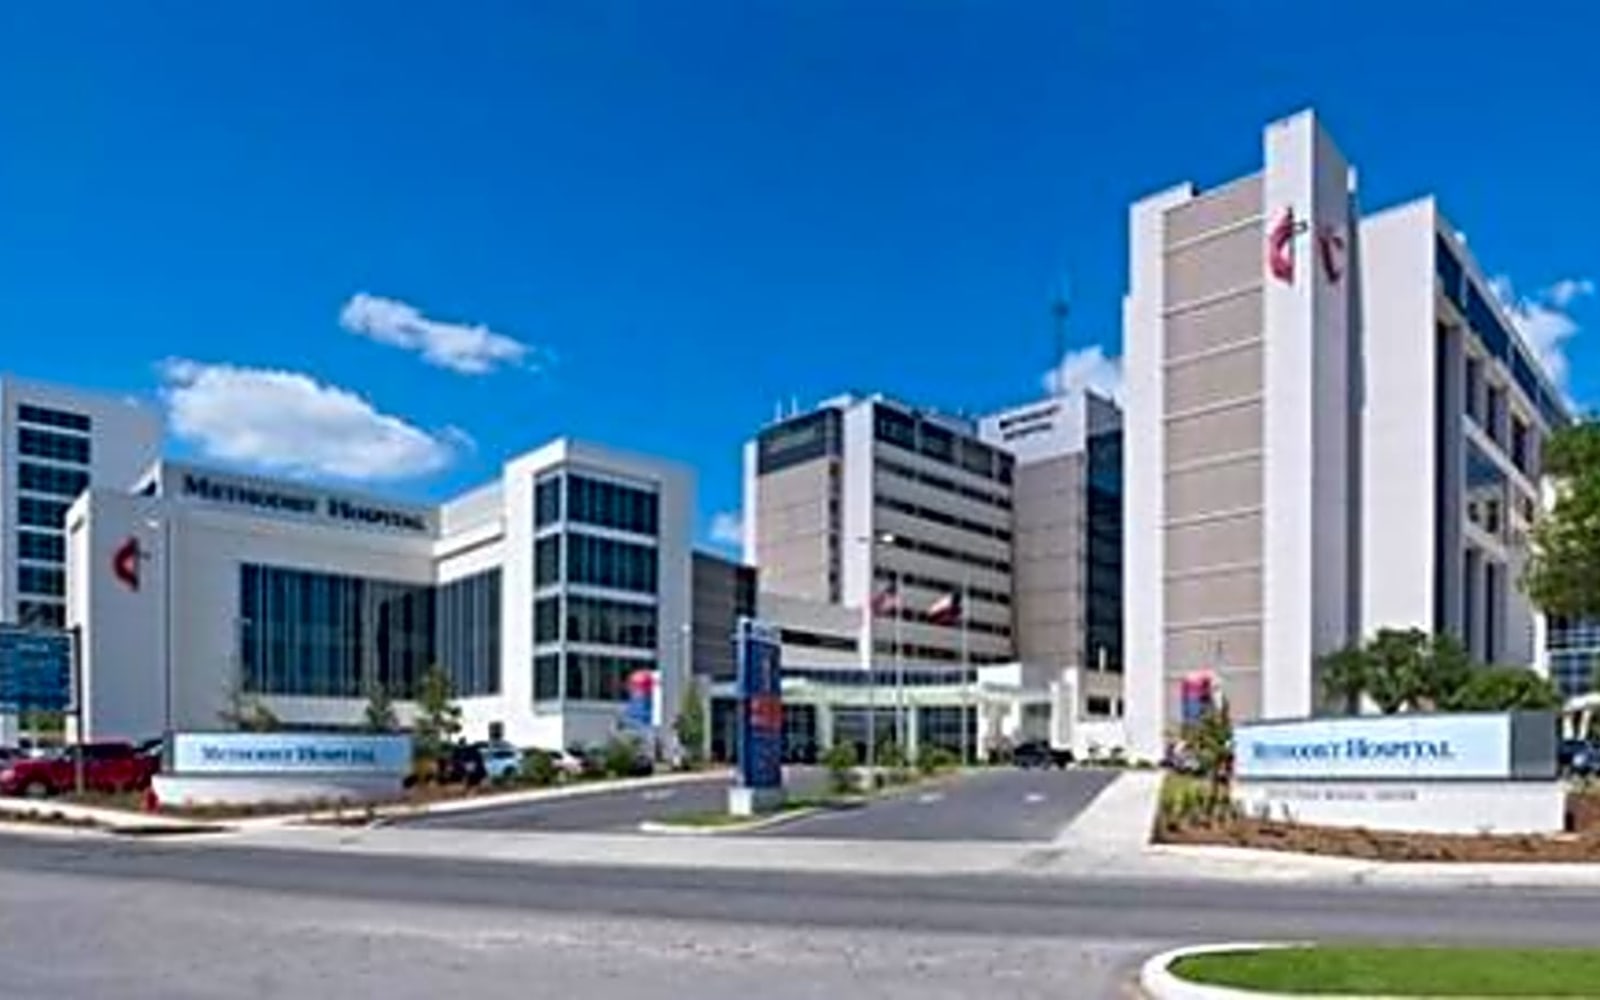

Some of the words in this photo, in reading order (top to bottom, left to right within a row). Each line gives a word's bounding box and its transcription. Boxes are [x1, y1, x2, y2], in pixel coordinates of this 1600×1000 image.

[326, 495, 428, 532] HOSPITAL
[1251, 740, 1341, 759] ODIST
[1345, 738, 1455, 760] HOSPITAL
